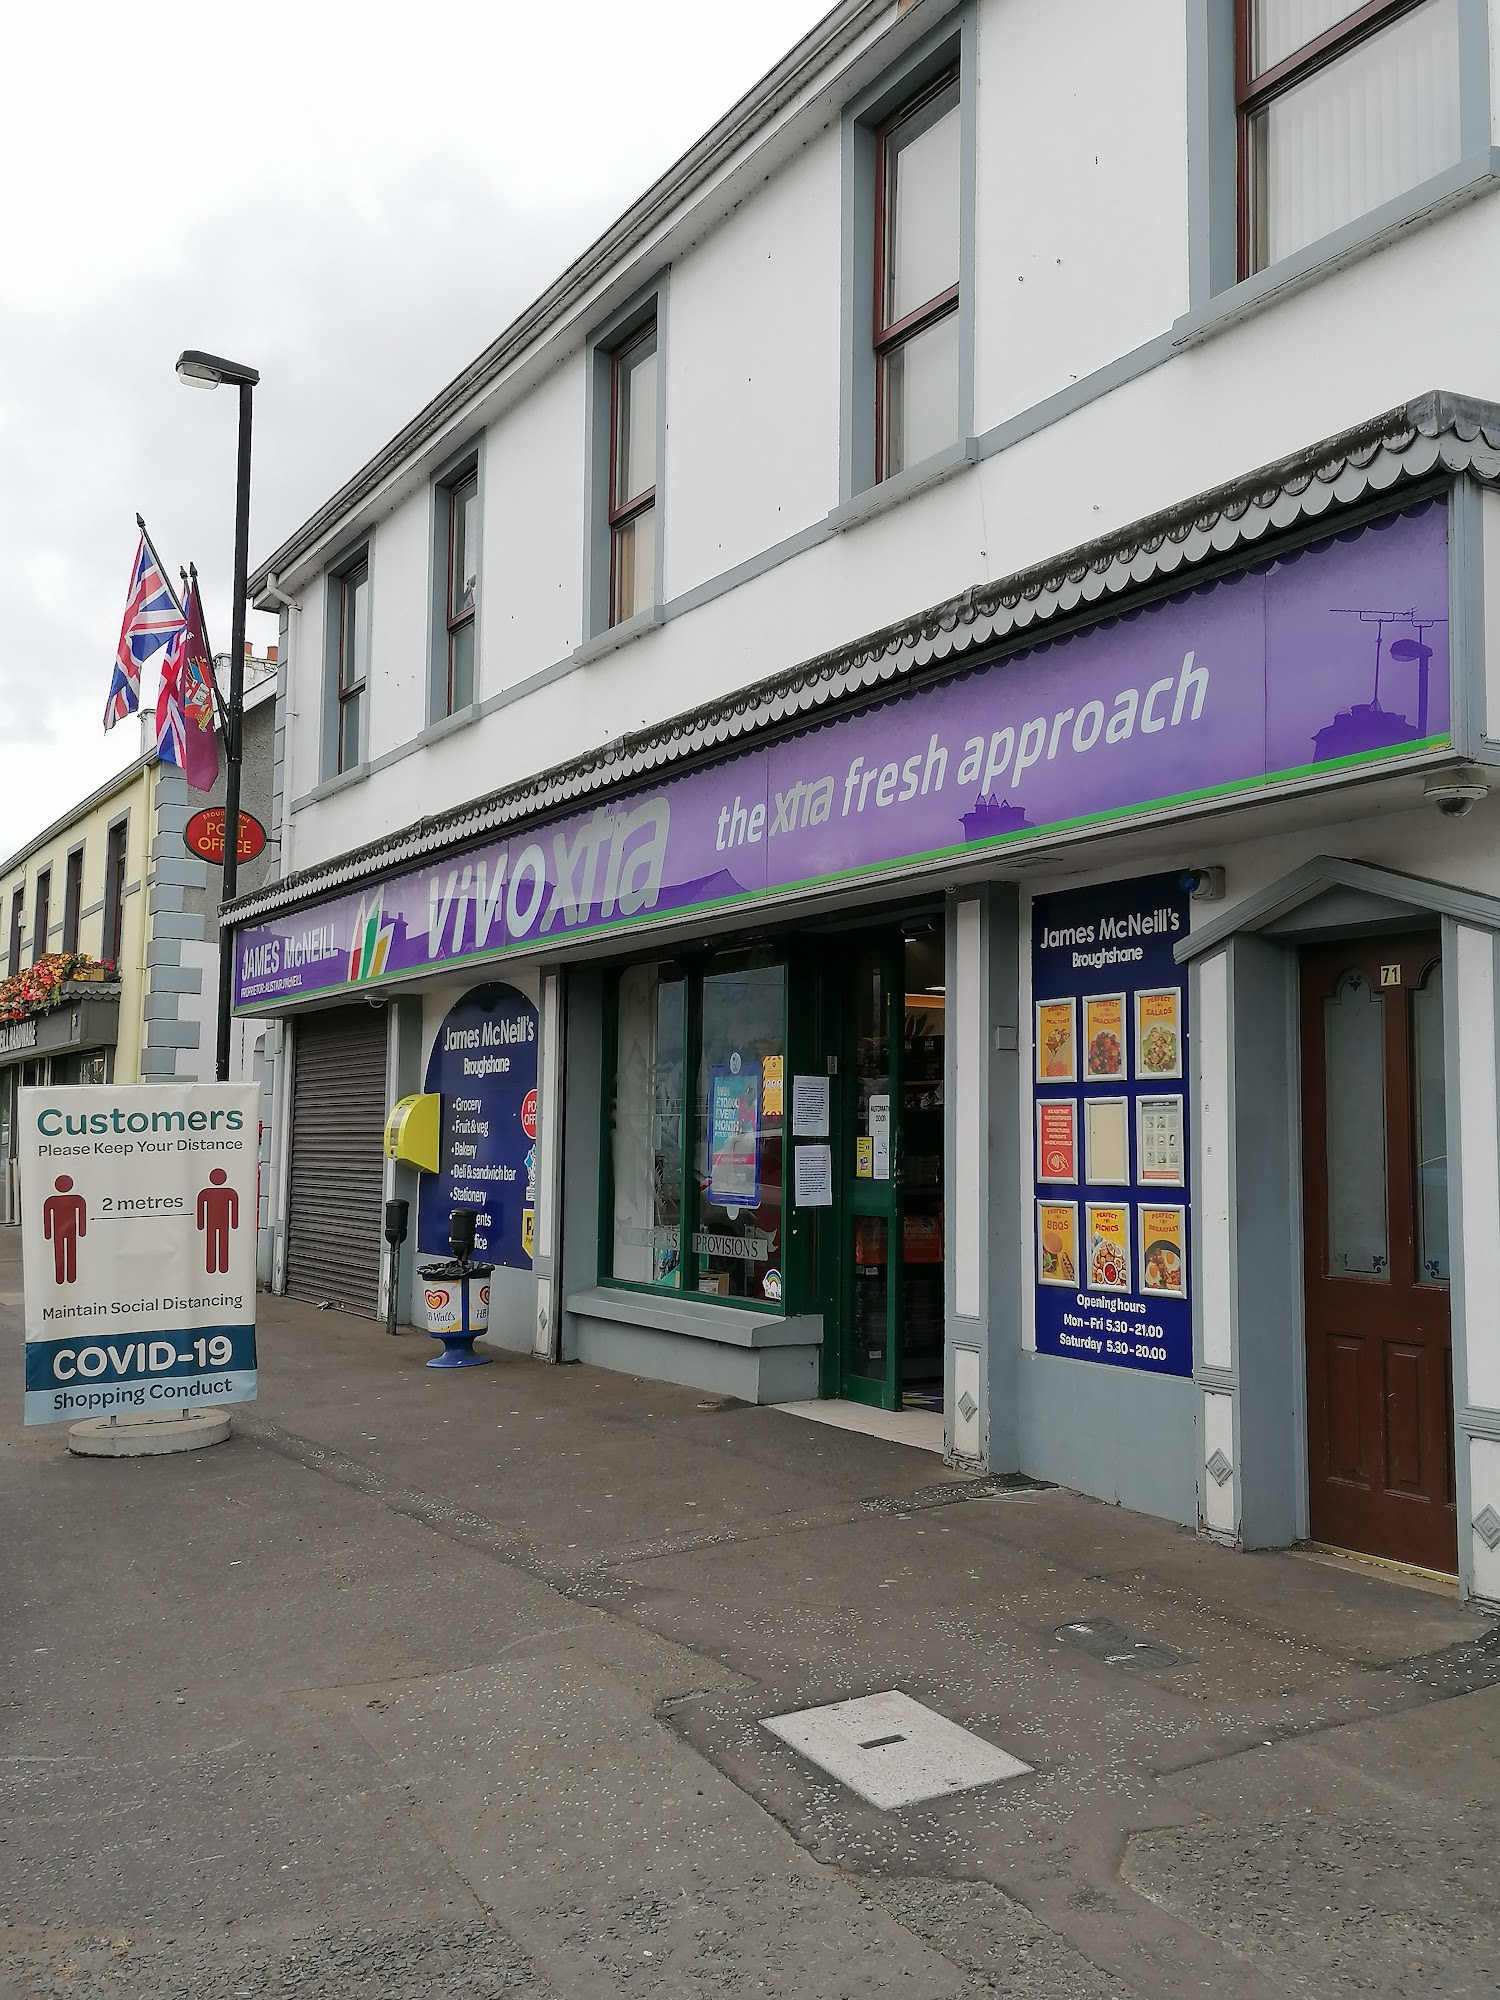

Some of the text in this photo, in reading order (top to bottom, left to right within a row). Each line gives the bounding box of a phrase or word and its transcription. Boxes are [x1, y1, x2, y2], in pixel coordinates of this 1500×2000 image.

[715, 650, 1209, 851] the xtra fresh approach
[206, 822, 247, 838] POT
[197, 837, 252, 853] OFFCE
[1041, 907, 1180, 949] James McNeill's
[241, 923, 339, 981] JAMES McNEILL
[1072, 945, 1144, 969] Broughshane
[1382, 967, 1397, 983] 71
[1147, 996, 1171, 1004] PERFECT
[1145, 1007, 1173, 1017] SALADS
[444, 1015, 534, 1051] James McNeill's
[464, 1055, 510, 1078] Broughshane
[456, 1097, 482, 1114] Grocery
[37, 1108, 244, 1137] Customers
[456, 1119, 471, 1134] Fruit
[476, 1121, 489, 1137] veg
[38, 1138, 243, 1157] Please Keep Your Distance
[454, 1142, 477, 1159] Bakery
[454, 1164, 467, 1179] Deli
[473, 1165, 504, 1181] sandwich
[504, 1165, 517, 1181] bar
[102, 1196, 184, 1211] 2 metres
[453, 1187, 487, 1206] Stationery
[1046, 1220, 1069, 1230] BBQS
[1151, 1212, 1176, 1220] PERFECT
[1095, 1223, 1119, 1232] PICNICS
[1148, 1224, 1179, 1233] BREAKFAST
[696, 1235, 758, 1258] PROVISIONS
[43, 1293, 243, 1321] Maintain Social Distancing
[1076, 1293, 1147, 1314] Opening hours
[1059, 1332, 1103, 1353] Saturday
[53, 1335, 233, 1380] COVID-19
[53, 1378, 233, 1410] Shopping Conduct
